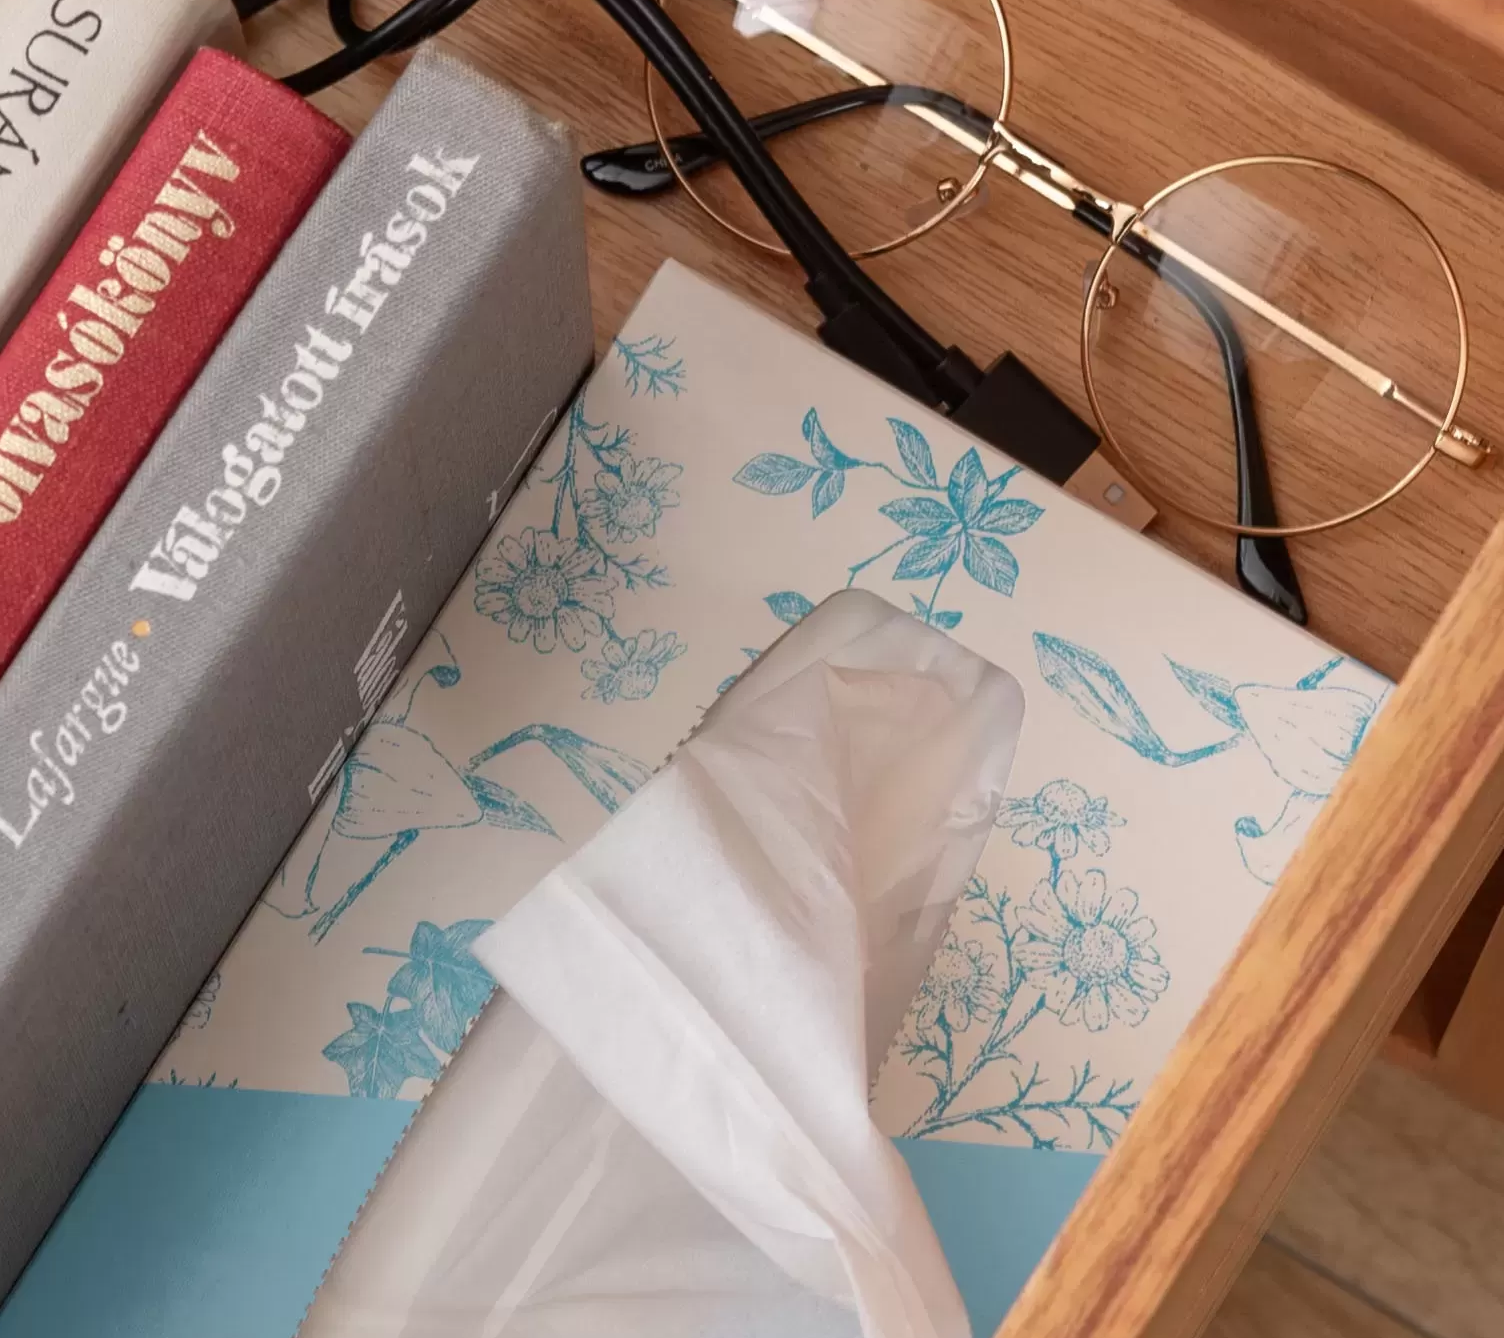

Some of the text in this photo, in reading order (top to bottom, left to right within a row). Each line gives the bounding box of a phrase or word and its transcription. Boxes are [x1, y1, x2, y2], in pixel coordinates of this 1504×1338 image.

[644, 155, 683, 172] CHIA
[128, 324, 353, 601] Válogatott
[325, 147, 481, 334] írások
